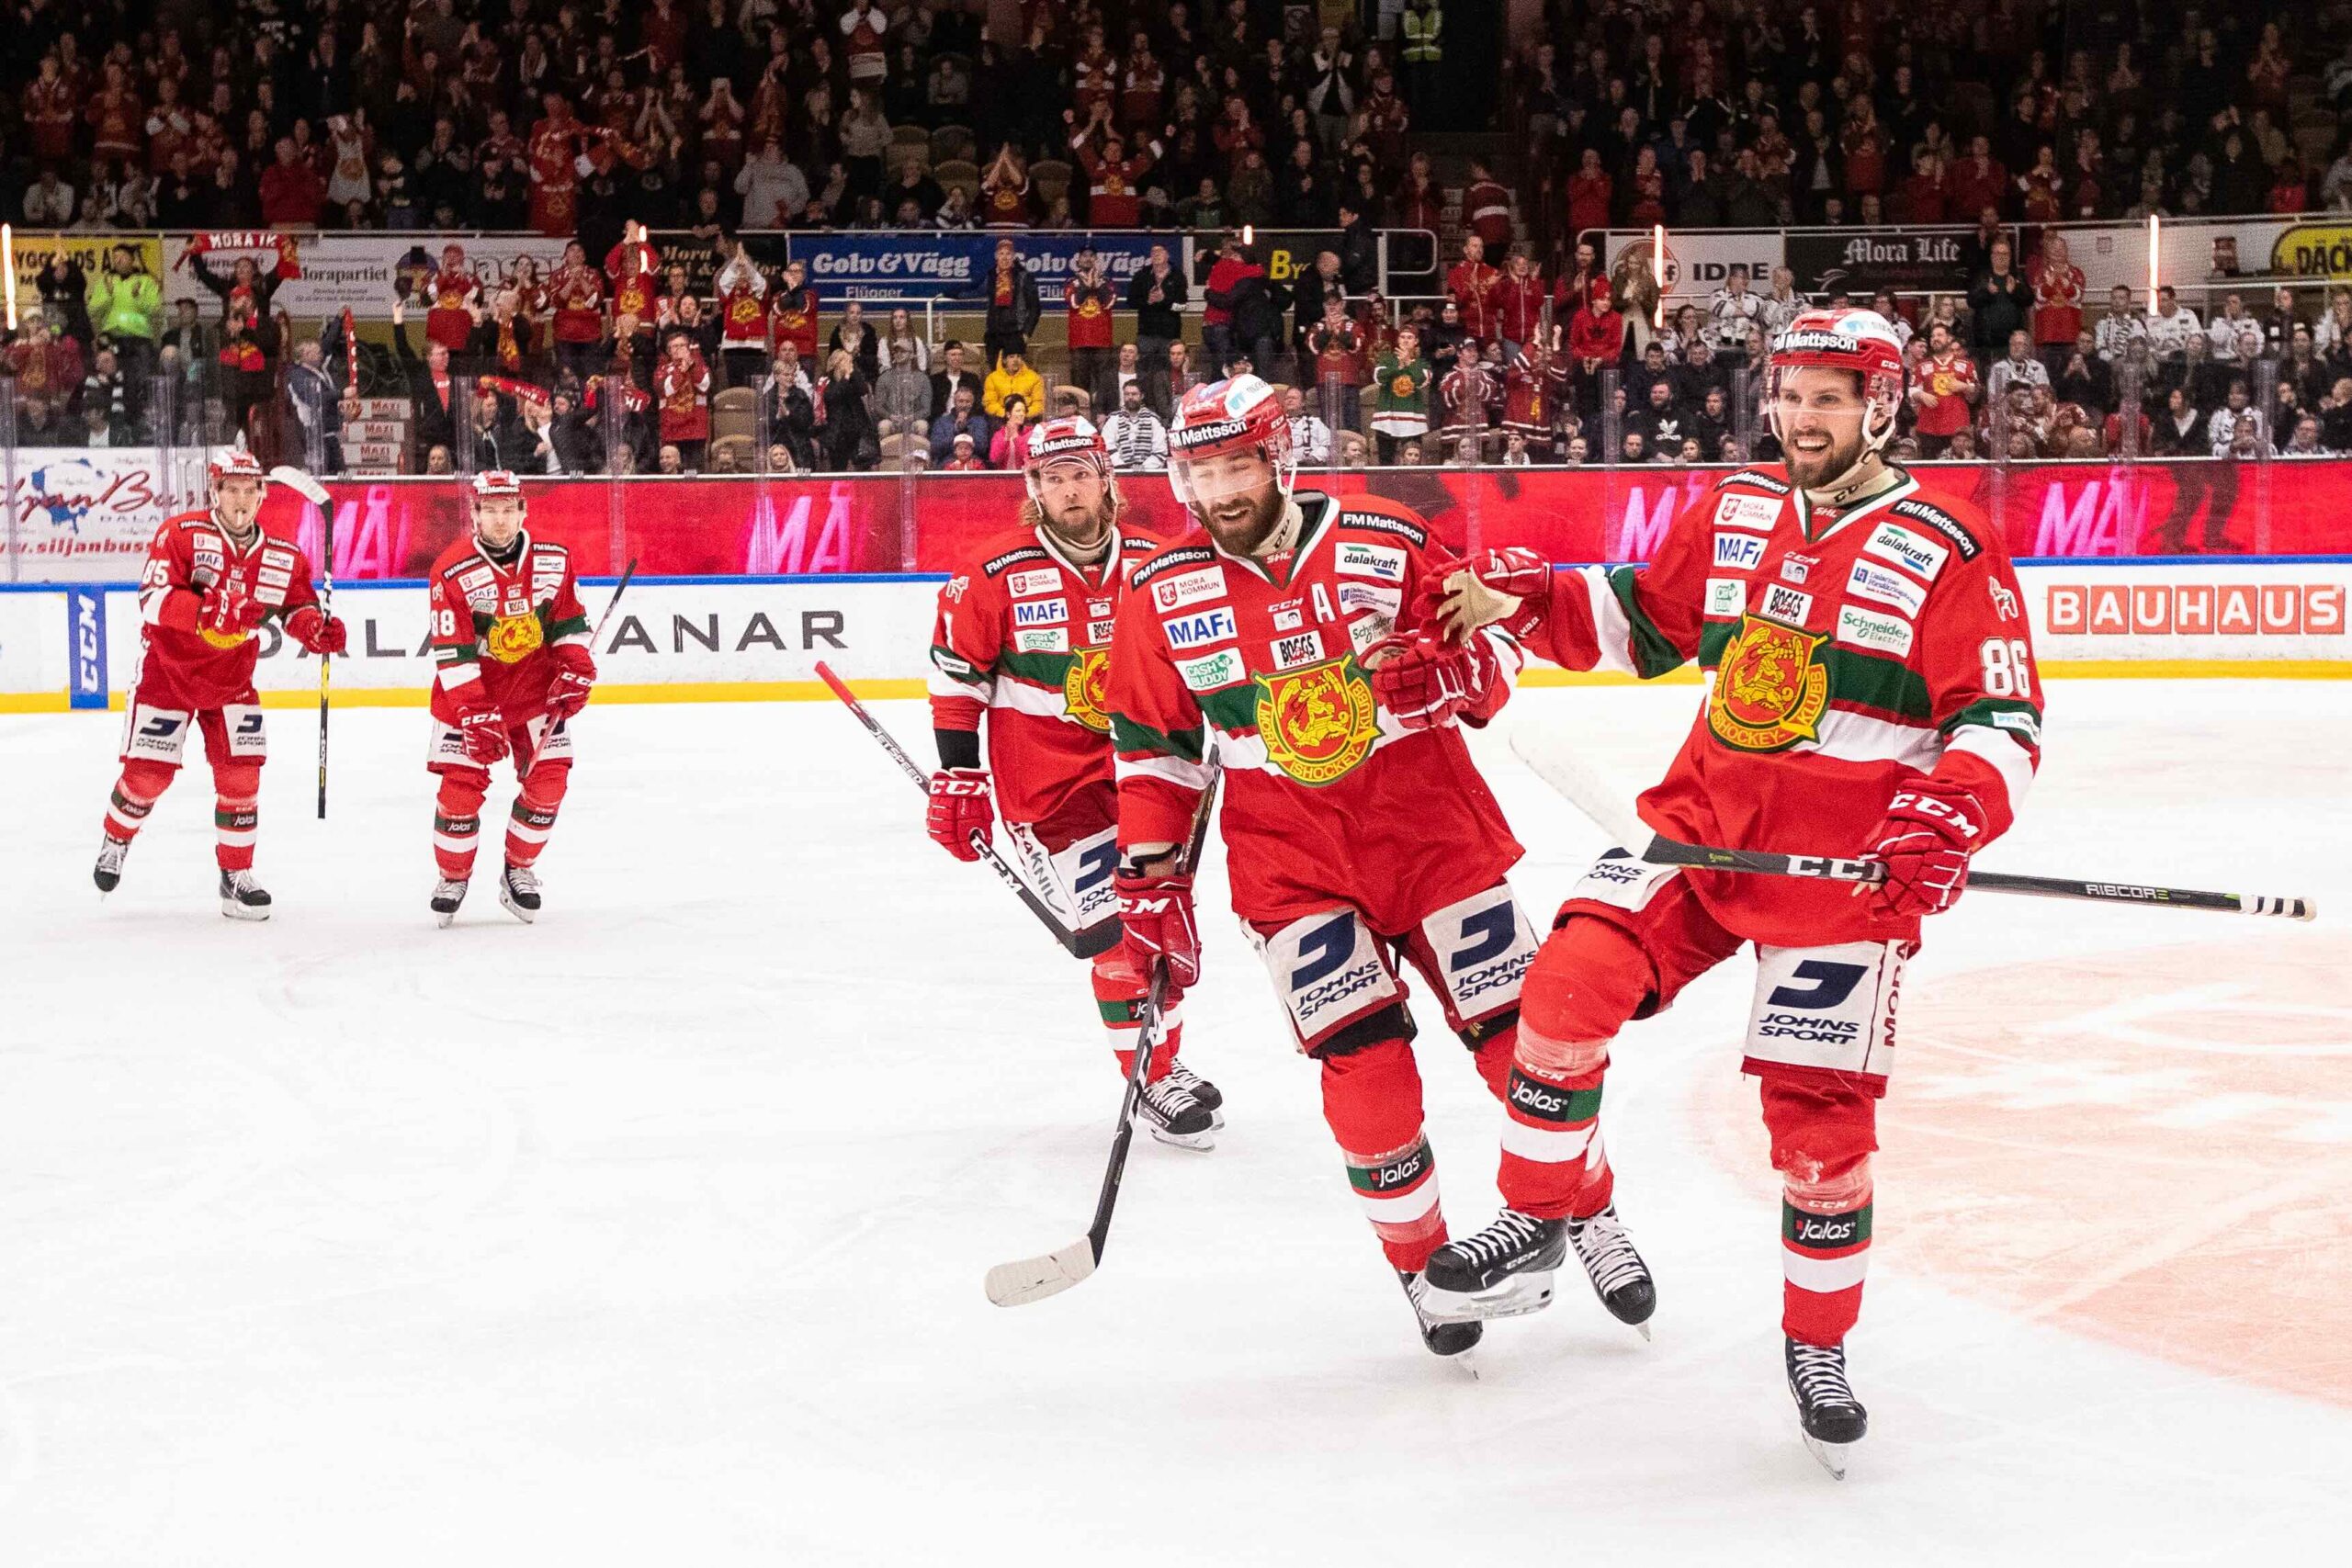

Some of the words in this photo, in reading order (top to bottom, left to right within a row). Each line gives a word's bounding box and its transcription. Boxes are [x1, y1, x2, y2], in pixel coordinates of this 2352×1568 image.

[209, 232, 254, 249] MORA
[1841, 238, 1907, 265] Mora
[1917, 238, 1961, 263] Life
[1786, 333, 1858, 352] Mattsson
[1182, 420, 1248, 443] Mattsson
[1045, 437, 1093, 453] Mattsson
[1814, 507, 1838, 517] SHL
[1343, 513, 1364, 526] FM
[1366, 514, 1424, 544] Mattsson
[1896, 501, 1918, 514] FM
[1917, 504, 1974, 557] Mattsson
[1266, 552, 1291, 564] SHL
[1783, 551, 1821, 565] CCM
[1877, 533, 1934, 566] dalakraft
[986, 561, 1003, 575] FM
[1001, 549, 1046, 566] Mattsson
[1134, 568, 1149, 585] FM
[1150, 550, 1211, 574] Mattsson
[1343, 552, 1398, 570] dalakraft
[1180, 577, 1205, 588] MORA
[1181, 581, 1220, 596] KOMMUN
[1268, 598, 1303, 613] CCM
[1311, 582, 1335, 623] A
[2050, 588, 2343, 631] BAUHAUS
[1843, 612, 1909, 640] Schneider
[1280, 635, 1316, 663] BOGGS
[1870, 632, 1906, 649] Electric
[1186, 661, 1218, 676] CASH
[1981, 637, 2031, 698] 86
[1191, 671, 1230, 688] BUDDY
[1351, 683, 1374, 730] KLUBB
[1798, 671, 1823, 724] KLUBB
[462, 713, 502, 726] CCM
[1259, 708, 1279, 751] MORA
[930, 780, 992, 797] CCM
[1889, 792, 1980, 838] CCM
[2086, 884, 2169, 901] RIBCORE
[1081, 893, 1117, 916] SPO
[1296, 960, 1379, 1010] JOHNS
[1300, 972, 1382, 1021] SPORT
[1758, 1013, 1860, 1032] JOHNS
[1758, 1026, 1857, 1044] SPORT
[1524, 1062, 1566, 1082] CCM
[1808, 1200, 1849, 1210] CCM
[1506, 1247, 1540, 1270] CCM
